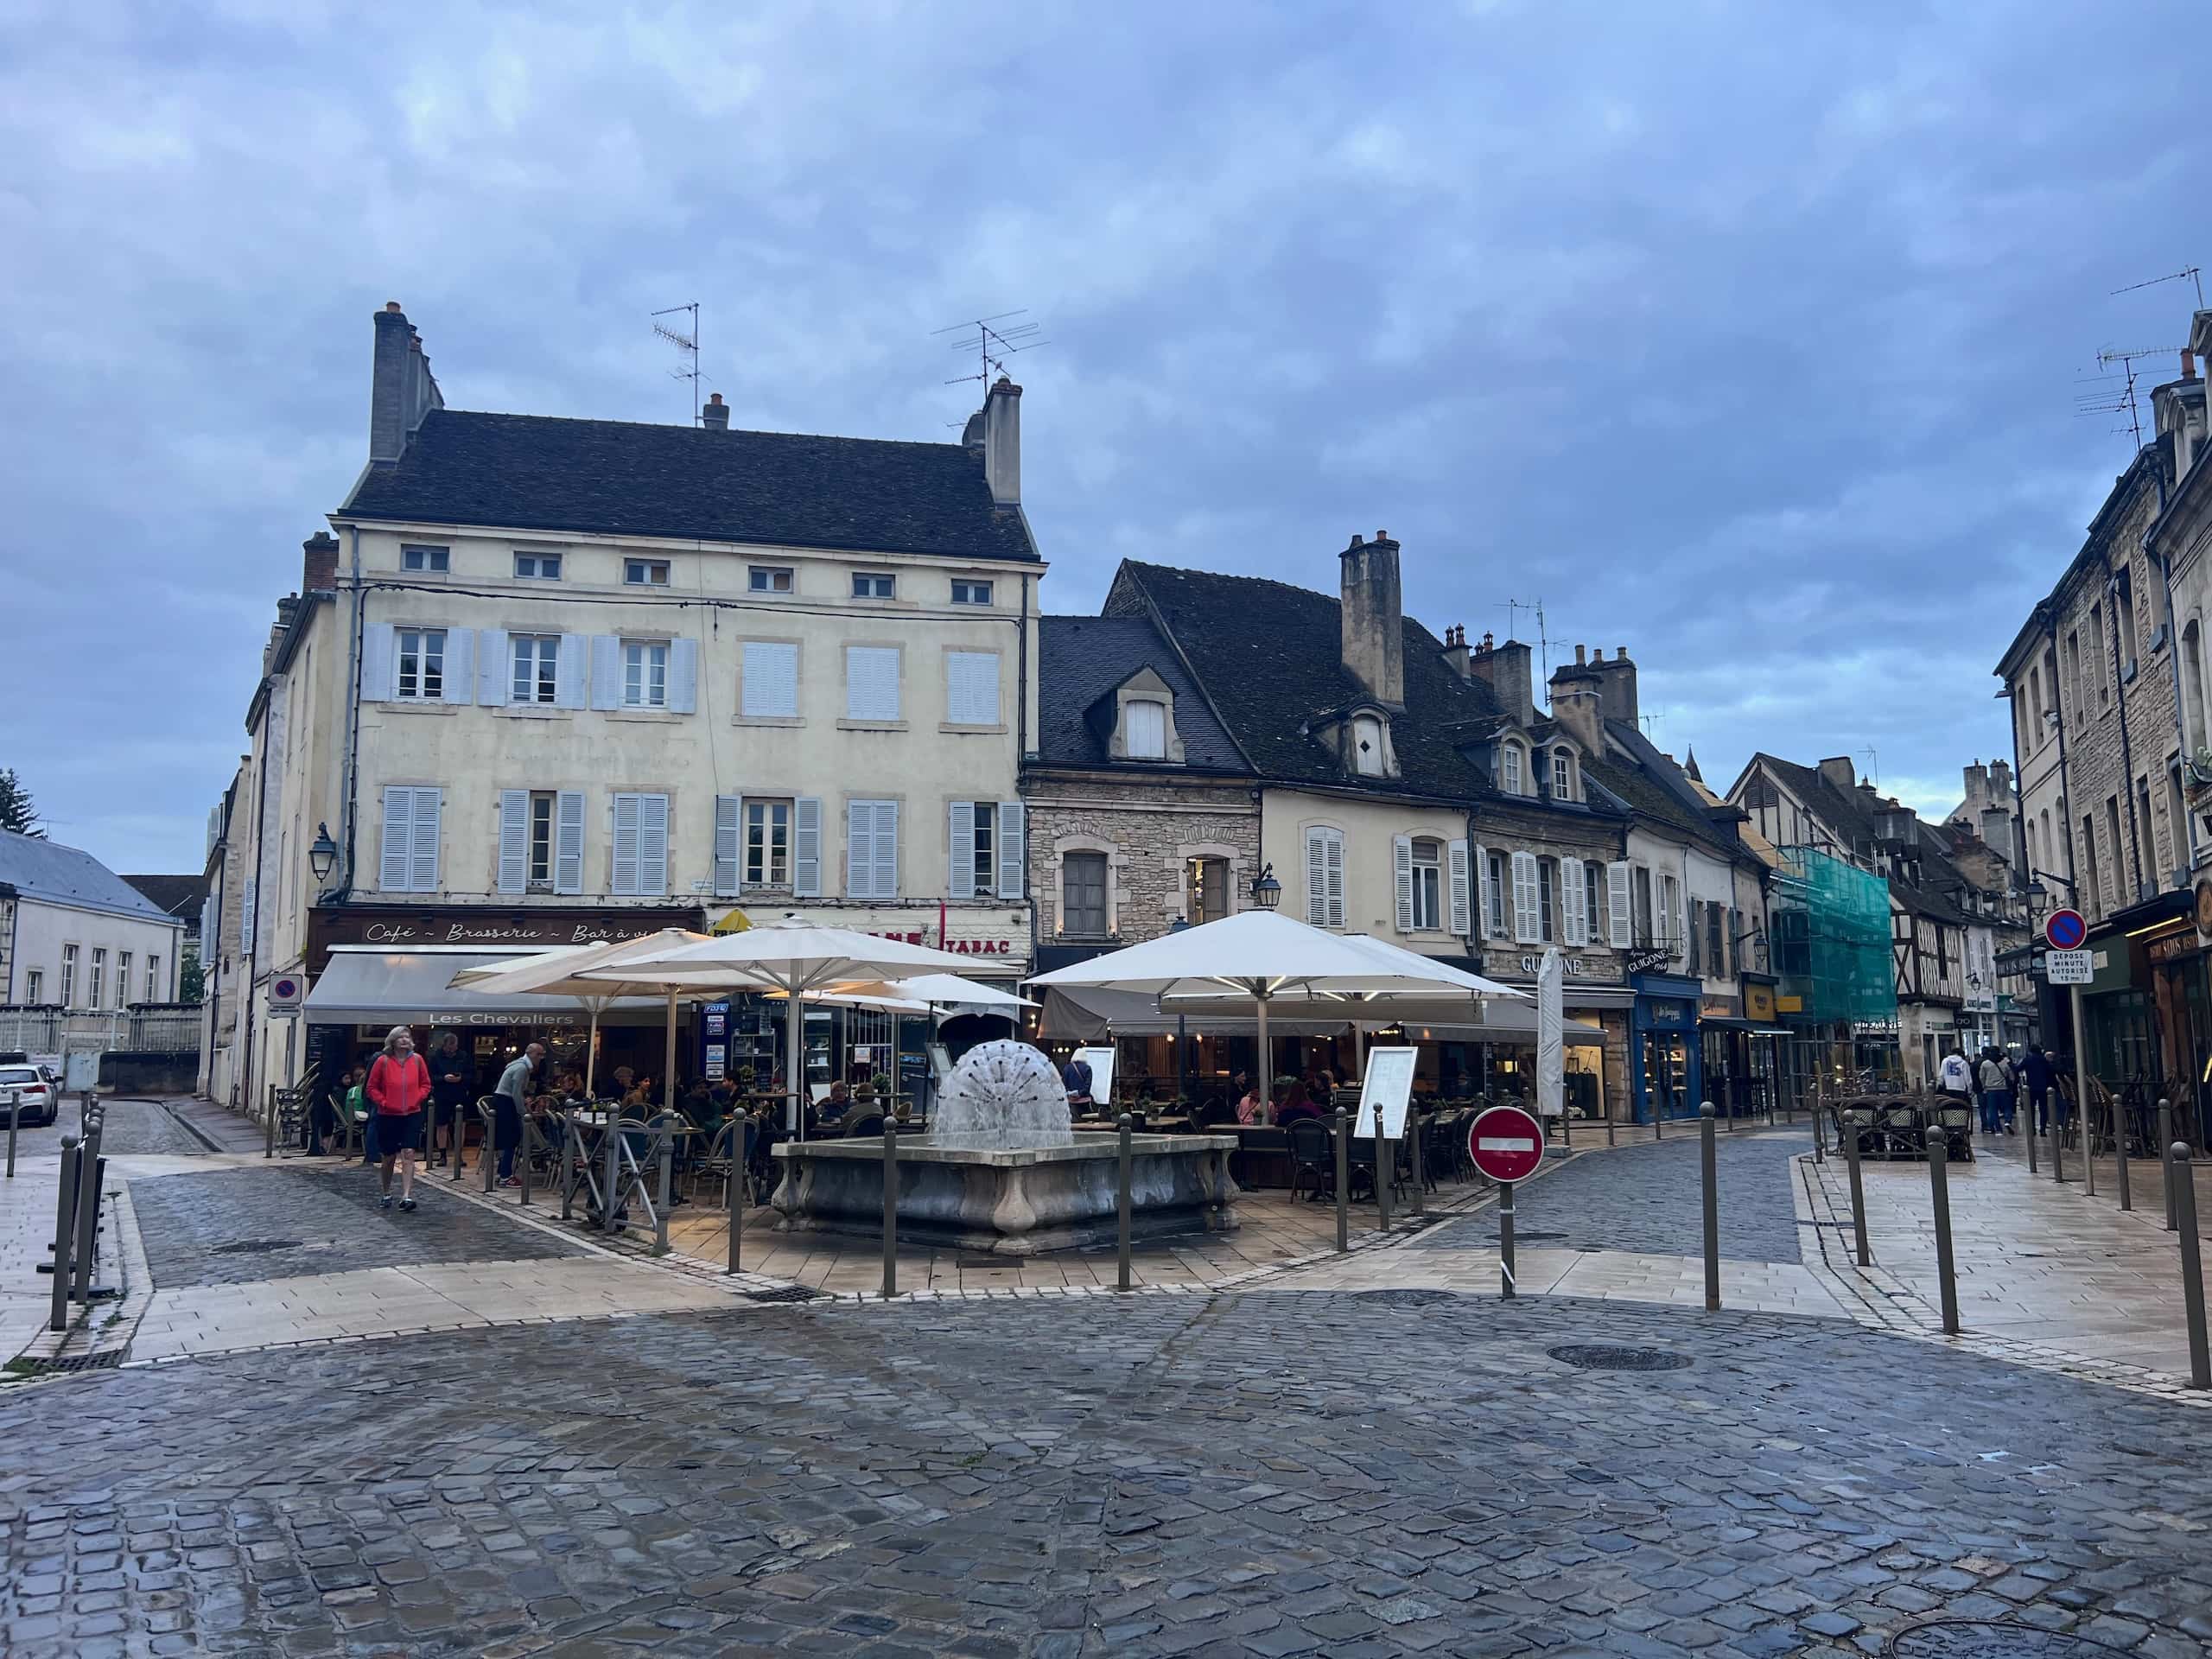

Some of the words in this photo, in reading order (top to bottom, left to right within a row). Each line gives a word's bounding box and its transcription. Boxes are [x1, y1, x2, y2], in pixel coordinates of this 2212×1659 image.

[366, 923, 416, 943] Café
[446, 923, 542, 942] Brasserie
[571, 925, 613, 943] Bar
[616, 929, 629, 938] à
[946, 940, 1009, 954] TABAC
[1628, 949, 1668, 973] GUIGONE
[429, 1013, 462, 1024] Les
[469, 1013, 575, 1025] Chevaliers
